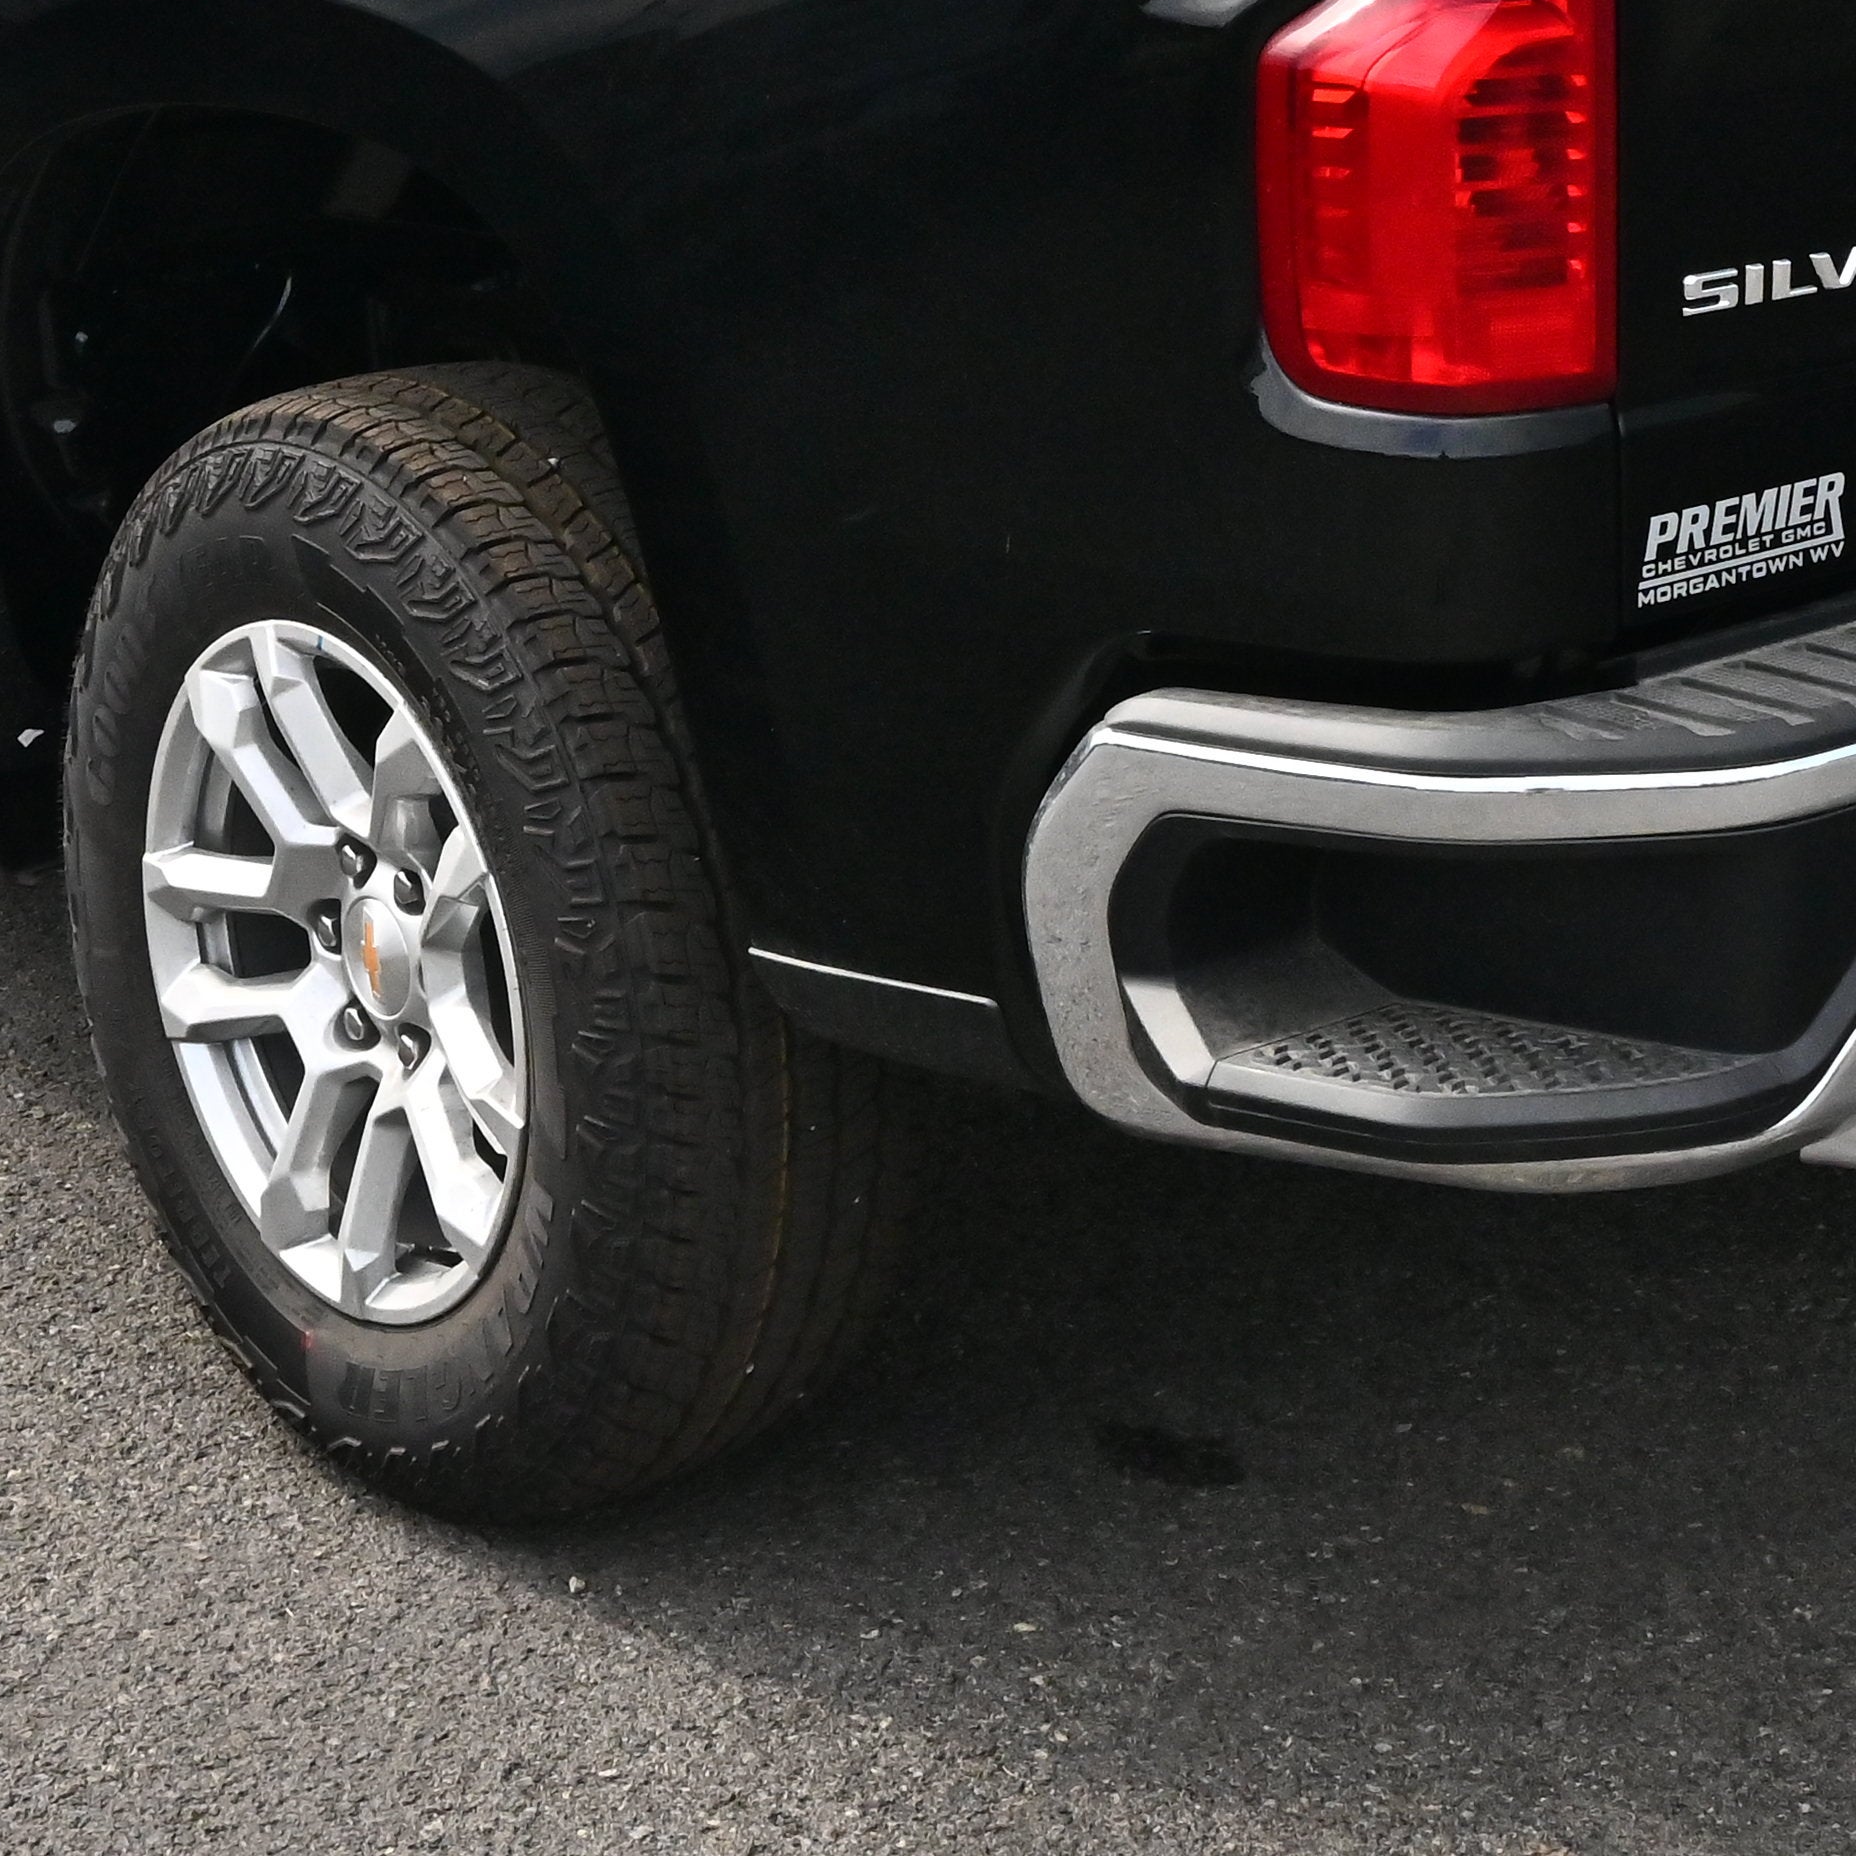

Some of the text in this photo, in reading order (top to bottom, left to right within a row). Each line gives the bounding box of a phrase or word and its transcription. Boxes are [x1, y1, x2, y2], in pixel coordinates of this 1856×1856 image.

[1642, 521, 1826, 578] CHEVROLET GMC
[1644, 472, 1846, 562] PREMIER
[1637, 541, 1845, 608] MORGANTOWN WV
